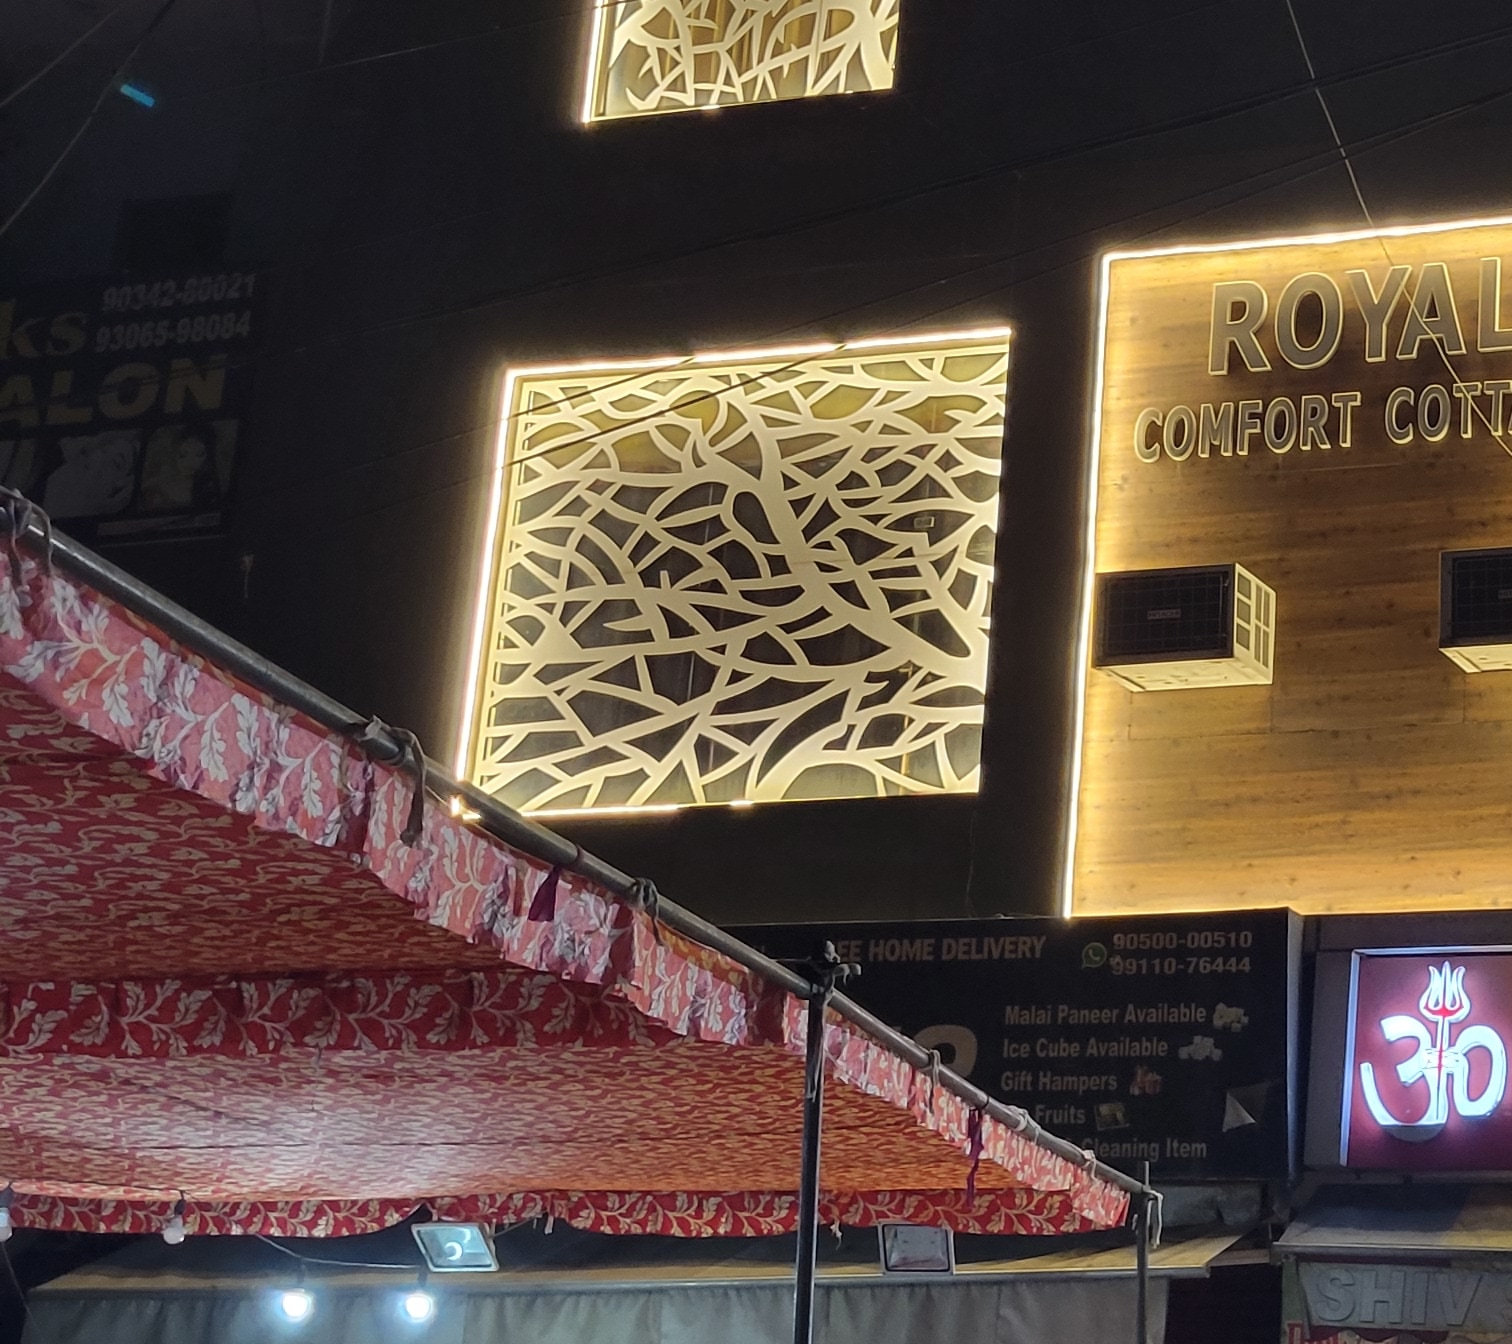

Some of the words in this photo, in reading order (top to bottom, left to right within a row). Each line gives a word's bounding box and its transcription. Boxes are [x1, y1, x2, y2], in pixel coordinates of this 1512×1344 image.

[1133, 391, 1361, 463] COMFORT
[869, 937, 940, 963] HOME
[942, 935, 1047, 961] DELIVERY
[1113, 931, 1253, 952] 90500-00510
[1110, 955, 1252, 977] 99110-76444
[1004, 1005, 1052, 1026] Malai
[1057, 1004, 1120, 1025] Paneer
[1124, 1003, 1207, 1024] Available
[1003, 1038, 1031, 1058] Ice
[1036, 1037, 1081, 1058] Cube
[1086, 1037, 1169, 1057] Available
[1001, 1071, 1033, 1092] Gift
[1038, 1071, 1118, 1095] Hampers
[1035, 1105, 1086, 1125] Fruits
[1166, 1138, 1208, 1158] Item
[1316, 1267, 1477, 1328] SHIV
